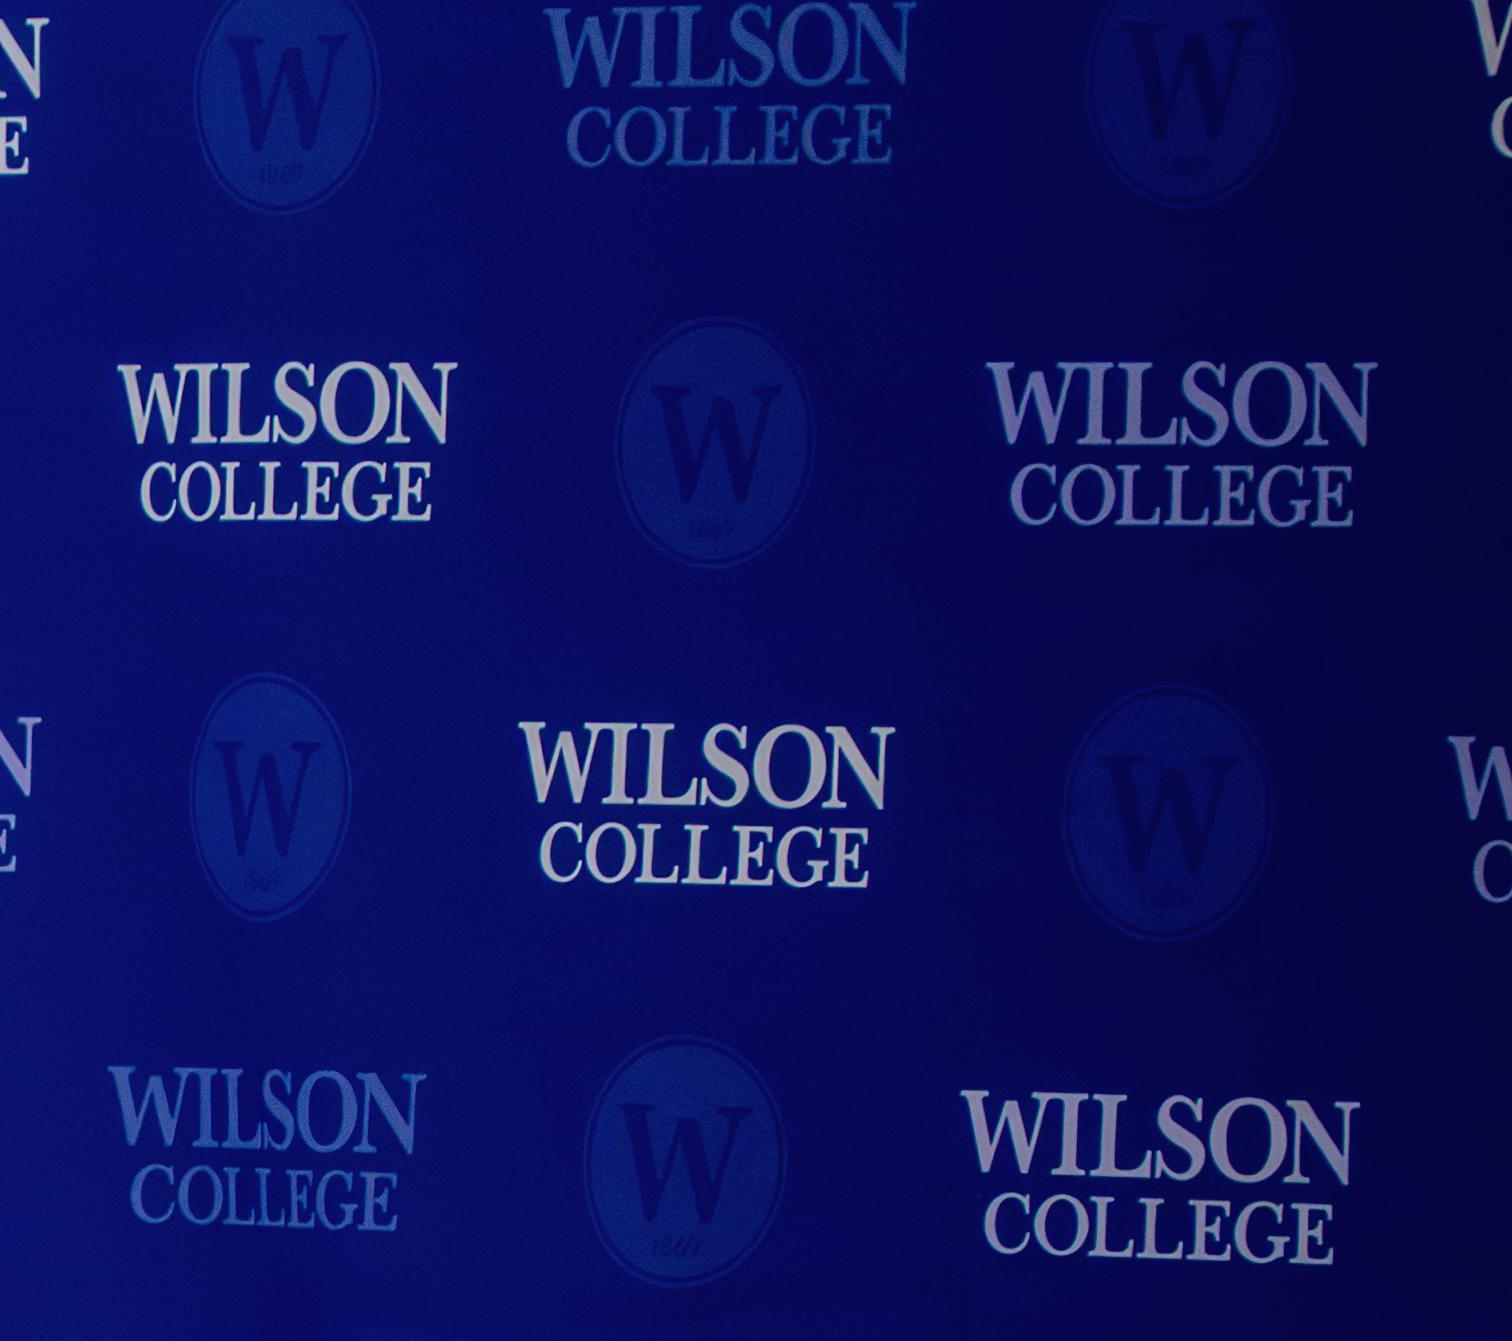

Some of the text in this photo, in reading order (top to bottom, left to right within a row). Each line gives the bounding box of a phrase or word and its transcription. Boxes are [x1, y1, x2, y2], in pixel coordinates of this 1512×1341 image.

[543, 2, 916, 88] WILSON
[1121, 18, 1254, 142] W
[228, 34, 348, 151] W
[567, 104, 891, 168] COLLEGE
[117, 361, 458, 444] WILSON
[654, 384, 782, 504] W
[986, 361, 1377, 447] WILSON
[140, 461, 431, 522] COLLEGE
[1010, 463, 1353, 527] COLLEGE
[214, 741, 320, 857] W
[518, 722, 895, 809] WILSON
[540, 821, 868, 888] COLLEGE
[1104, 755, 1239, 881] W
[108, 1066, 427, 1154] WILSON
[960, 1090, 1360, 1185] WILSON
[130, 1164, 397, 1231] COLLEGE
[619, 1104, 753, 1224] W
[984, 1192, 1333, 1265] COLLEGE
